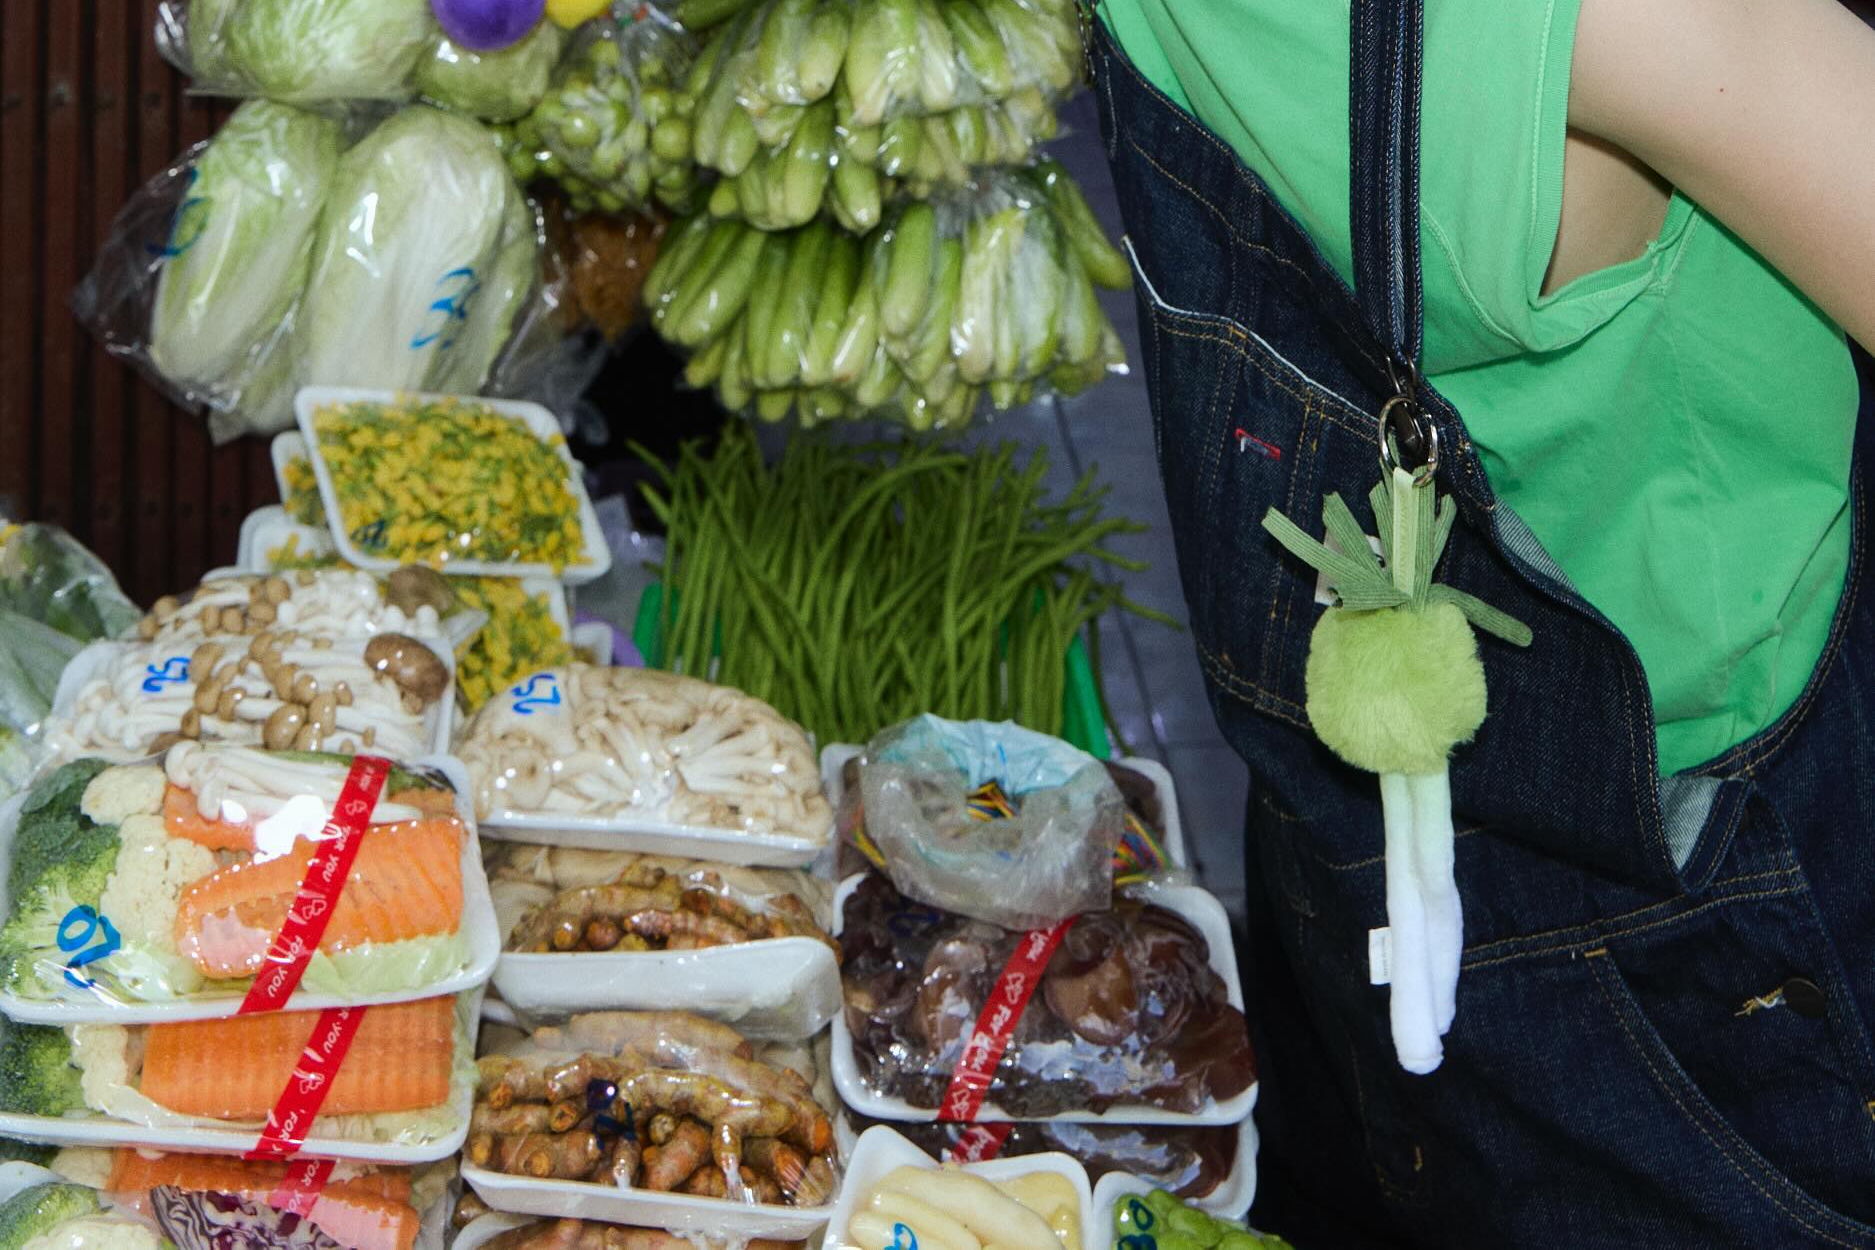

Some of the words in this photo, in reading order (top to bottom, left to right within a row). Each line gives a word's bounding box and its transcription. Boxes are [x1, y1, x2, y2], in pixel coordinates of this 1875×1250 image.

[322, 853, 340, 883] YOU
[287, 934, 304, 964] FOR
[267, 966, 288, 998] YOU
[323, 1022, 343, 1055] YOU
[278, 1110, 299, 1141] FOR
[286, 1189, 305, 1213] YO
